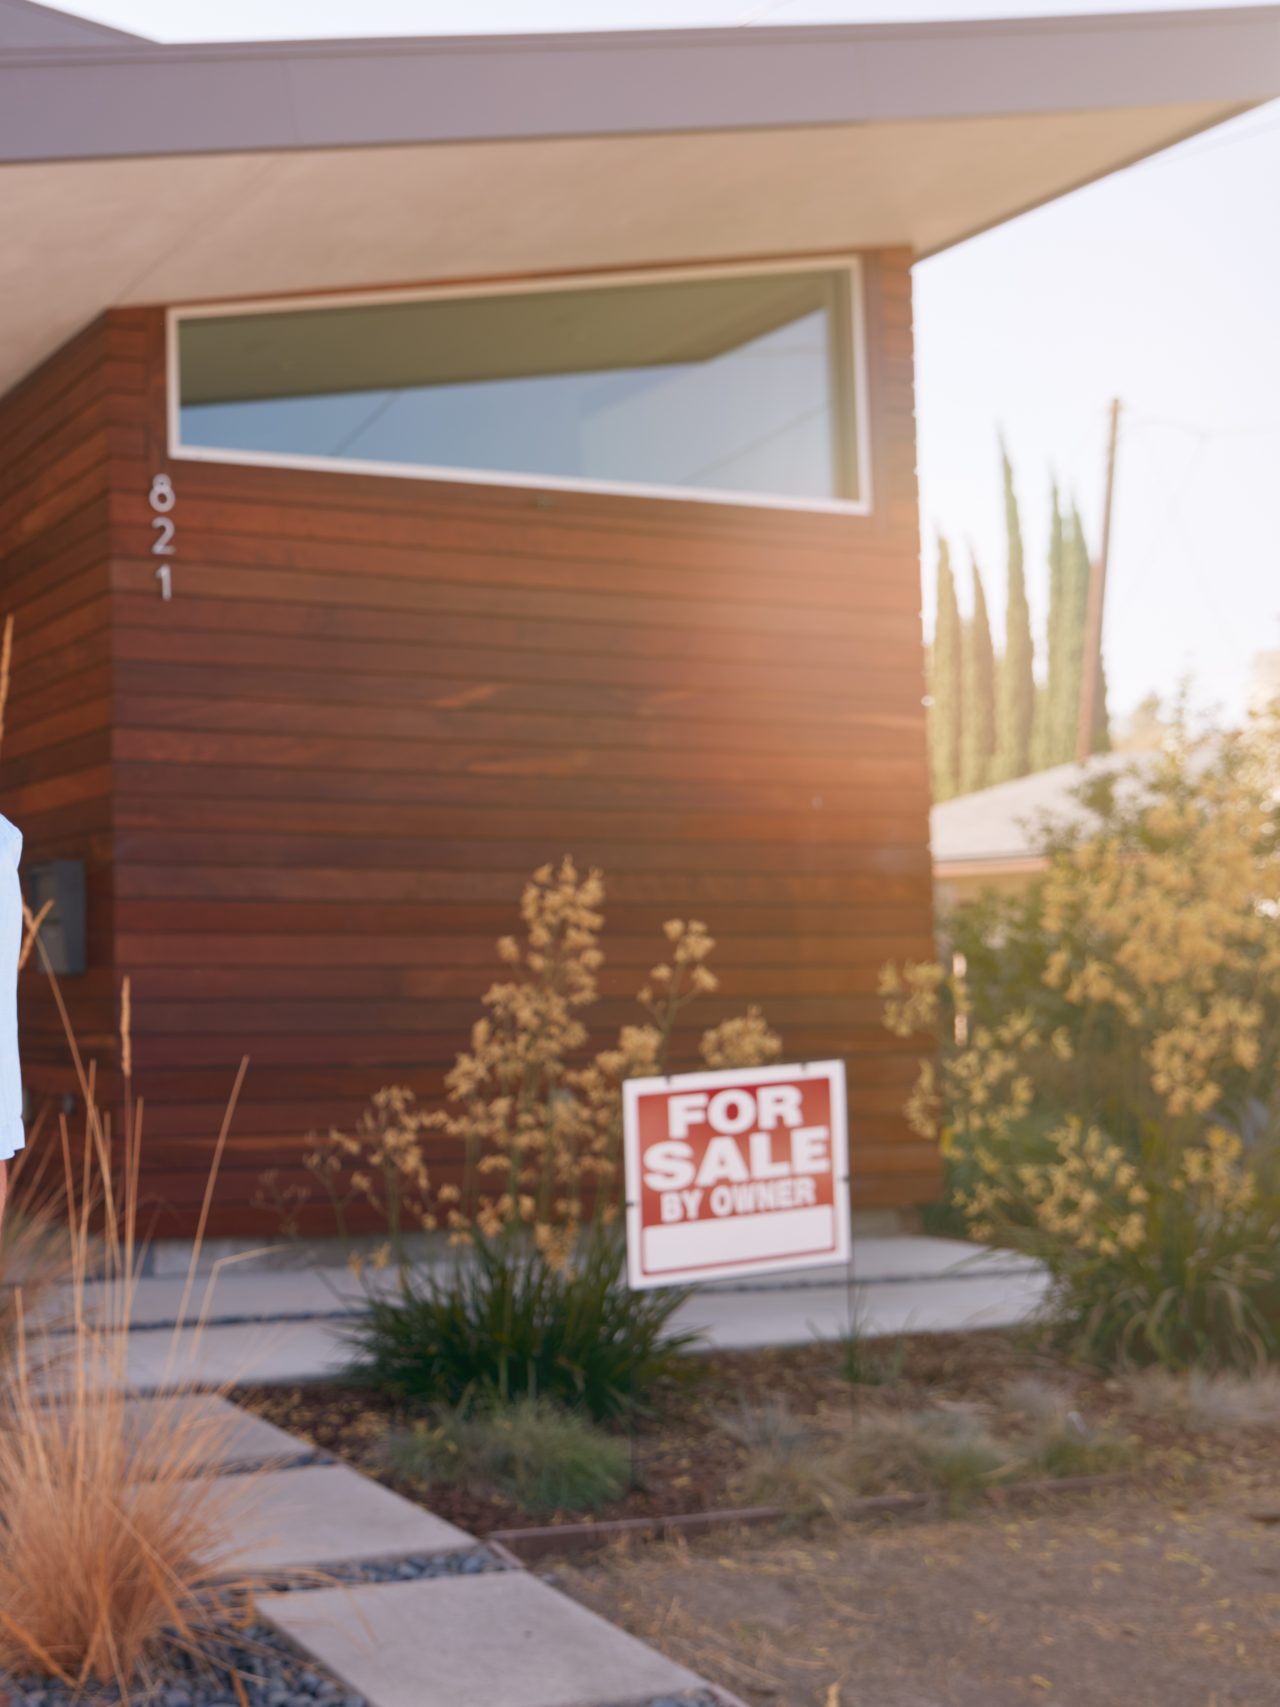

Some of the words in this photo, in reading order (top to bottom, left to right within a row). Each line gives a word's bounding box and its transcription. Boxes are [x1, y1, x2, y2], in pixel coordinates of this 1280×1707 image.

[149, 473, 176, 601] 821
[667, 1085, 803, 1139] FOR
[643, 1125, 831, 1191] SALE
[660, 1188, 703, 1223] BY
[709, 1177, 817, 1217] OWNER
